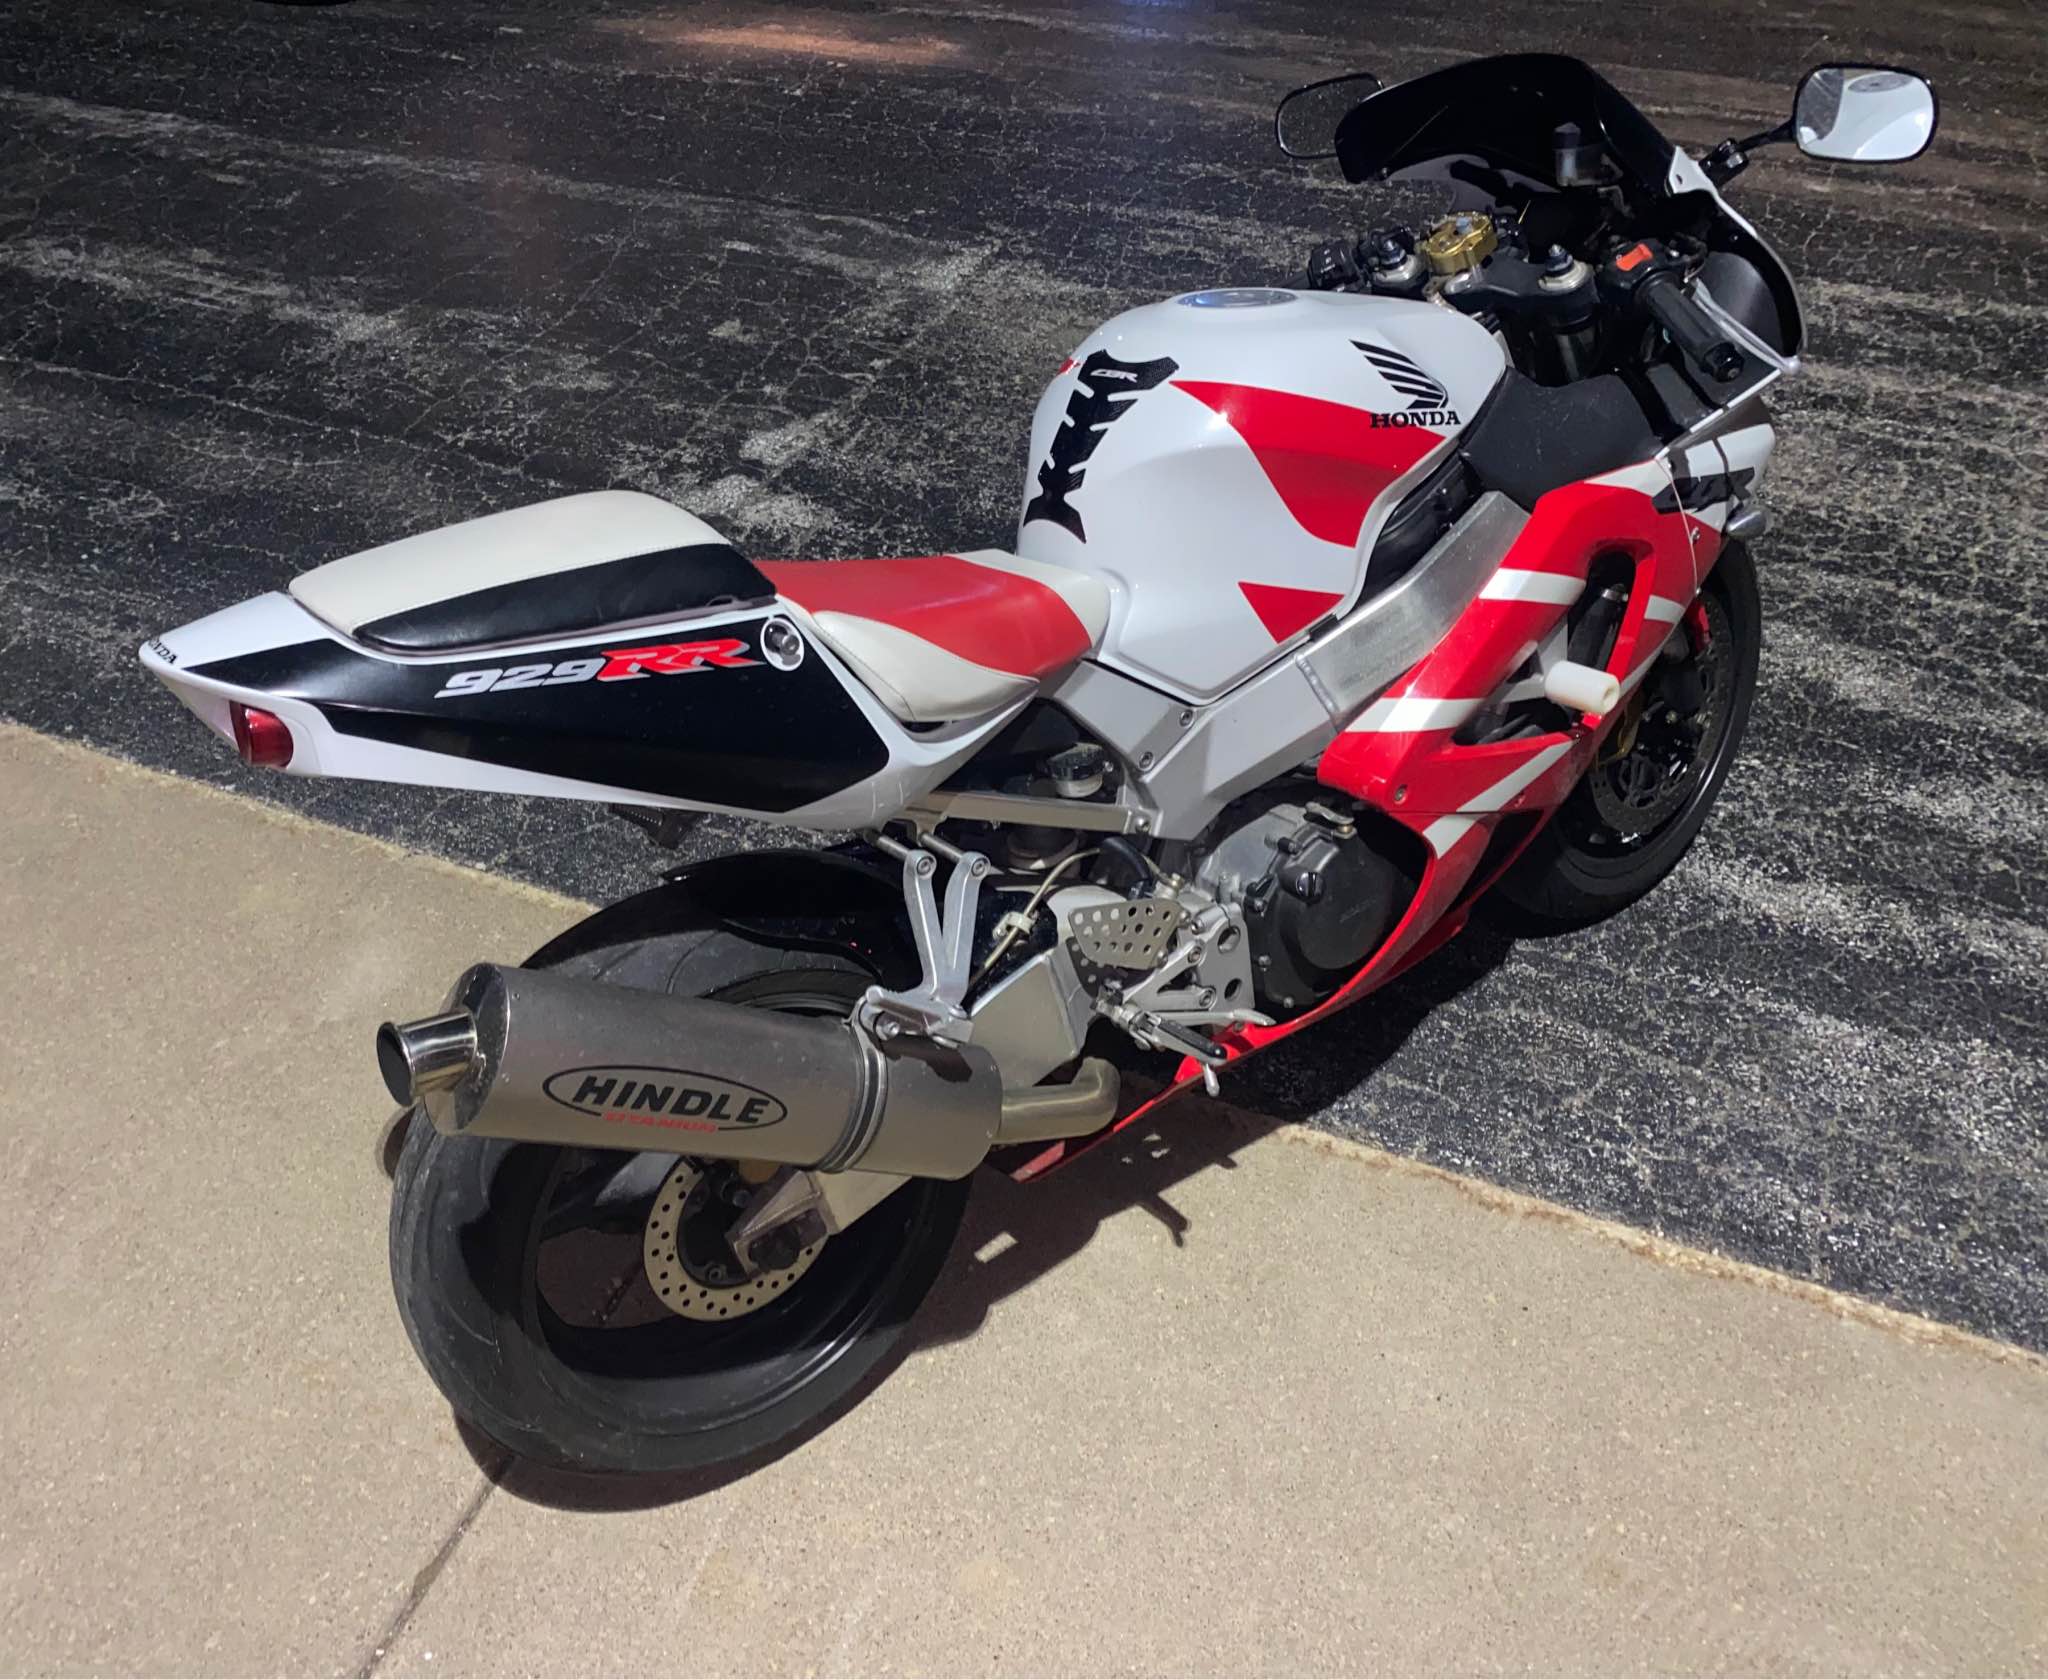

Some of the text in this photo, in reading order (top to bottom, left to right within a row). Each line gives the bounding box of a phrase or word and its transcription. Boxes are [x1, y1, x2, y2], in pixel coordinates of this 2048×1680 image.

[1369, 411, 1462, 429] HONDA
[433, 639, 767, 698] 929RR
[572, 1075, 770, 1123] HINDLE
